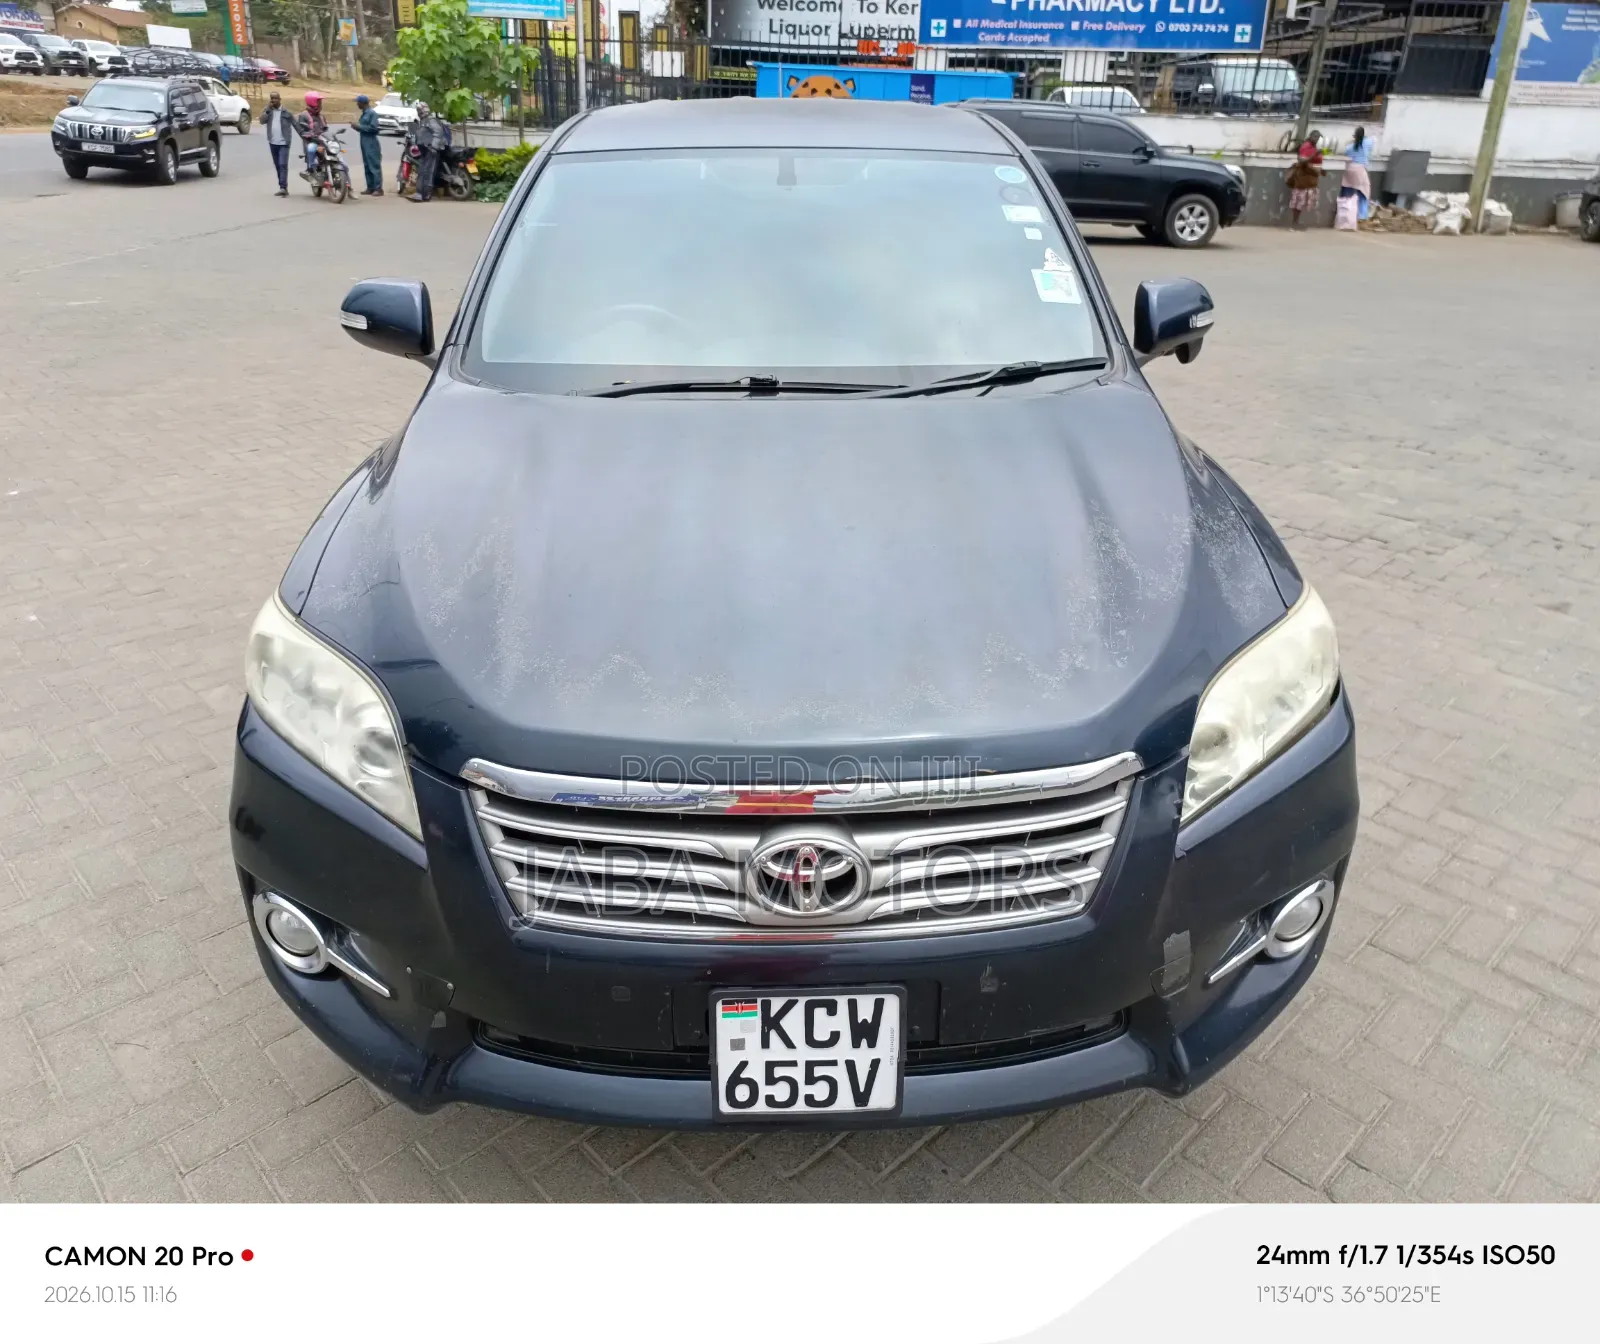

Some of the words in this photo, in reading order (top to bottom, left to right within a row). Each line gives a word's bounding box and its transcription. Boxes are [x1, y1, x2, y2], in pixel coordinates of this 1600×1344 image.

[757, 0, 841, 13] Welcom
[857, 0, 878, 14] To
[231, 0, 243, 43] 2022
[769, 18, 831, 39] Liquor
[839, 24, 916, 40] uperm
[965, 19, 978, 29] All
[980, 19, 1017, 30] Medical
[1019, 20, 1065, 31] Insurance
[1082, 20, 1103, 31] Free
[1105, 21, 1146, 34] Delivery
[978, 32, 1006, 42] Cards
[1007, 33, 1050, 44] Accepted
[761, 998, 885, 1049] KCW
[725, 1058, 881, 1108] 655V
